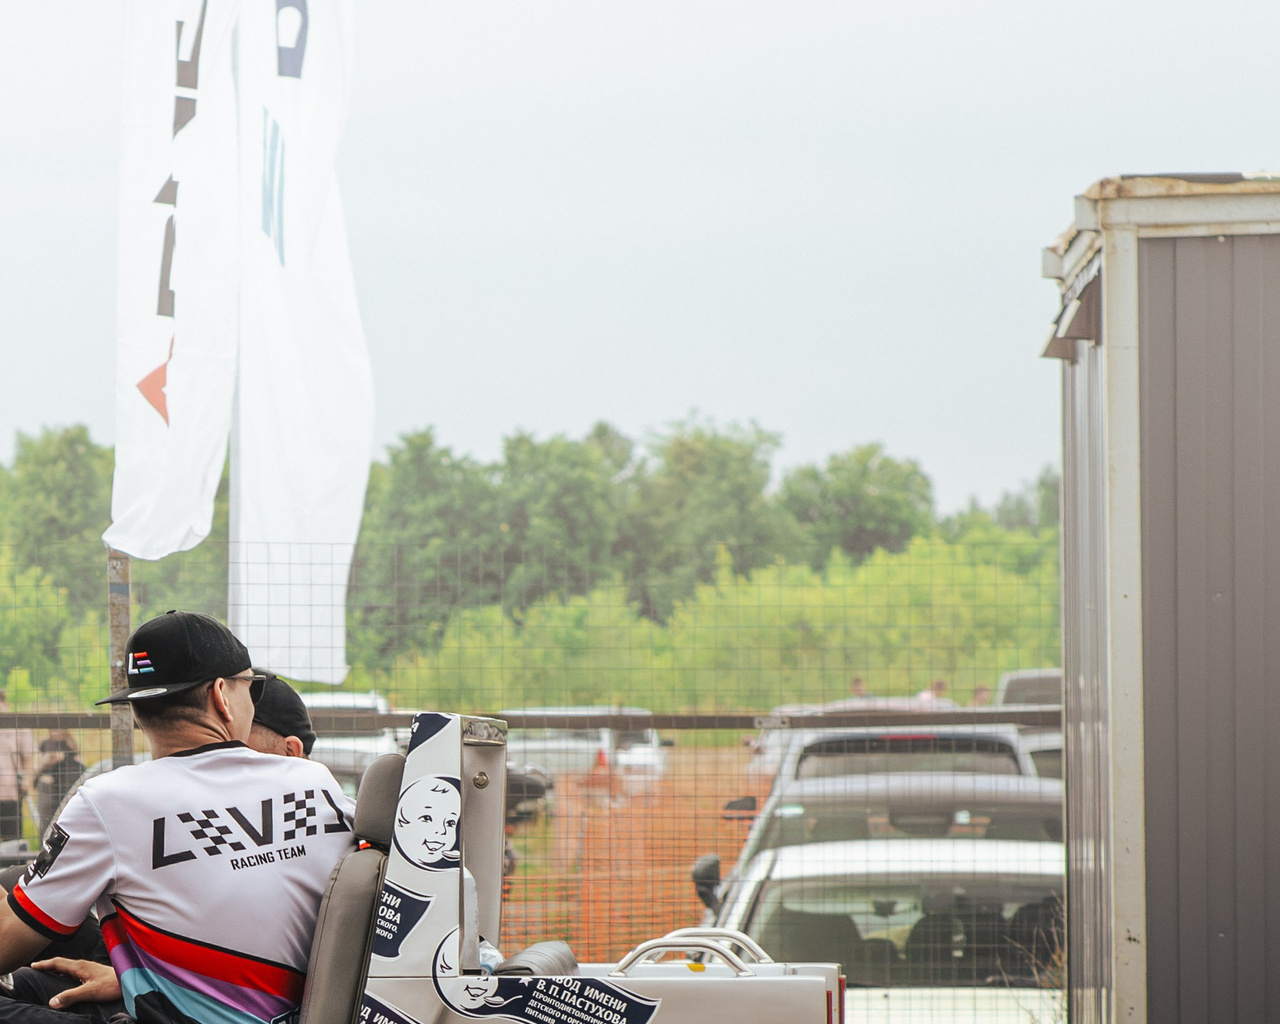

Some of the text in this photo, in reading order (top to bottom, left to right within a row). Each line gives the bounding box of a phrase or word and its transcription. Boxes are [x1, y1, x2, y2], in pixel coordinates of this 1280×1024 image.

[230, 844, 306, 871] RACING TEAM
[536, 979, 547, 992] В.
[548, 983, 559, 998] П.
[583, 985, 628, 1013] ИМЕНИ
[360, 1004, 372, 1020] Д
[527, 998, 561, 1018] ДЕТСКОГО
[560, 1011, 568, 1020] И
